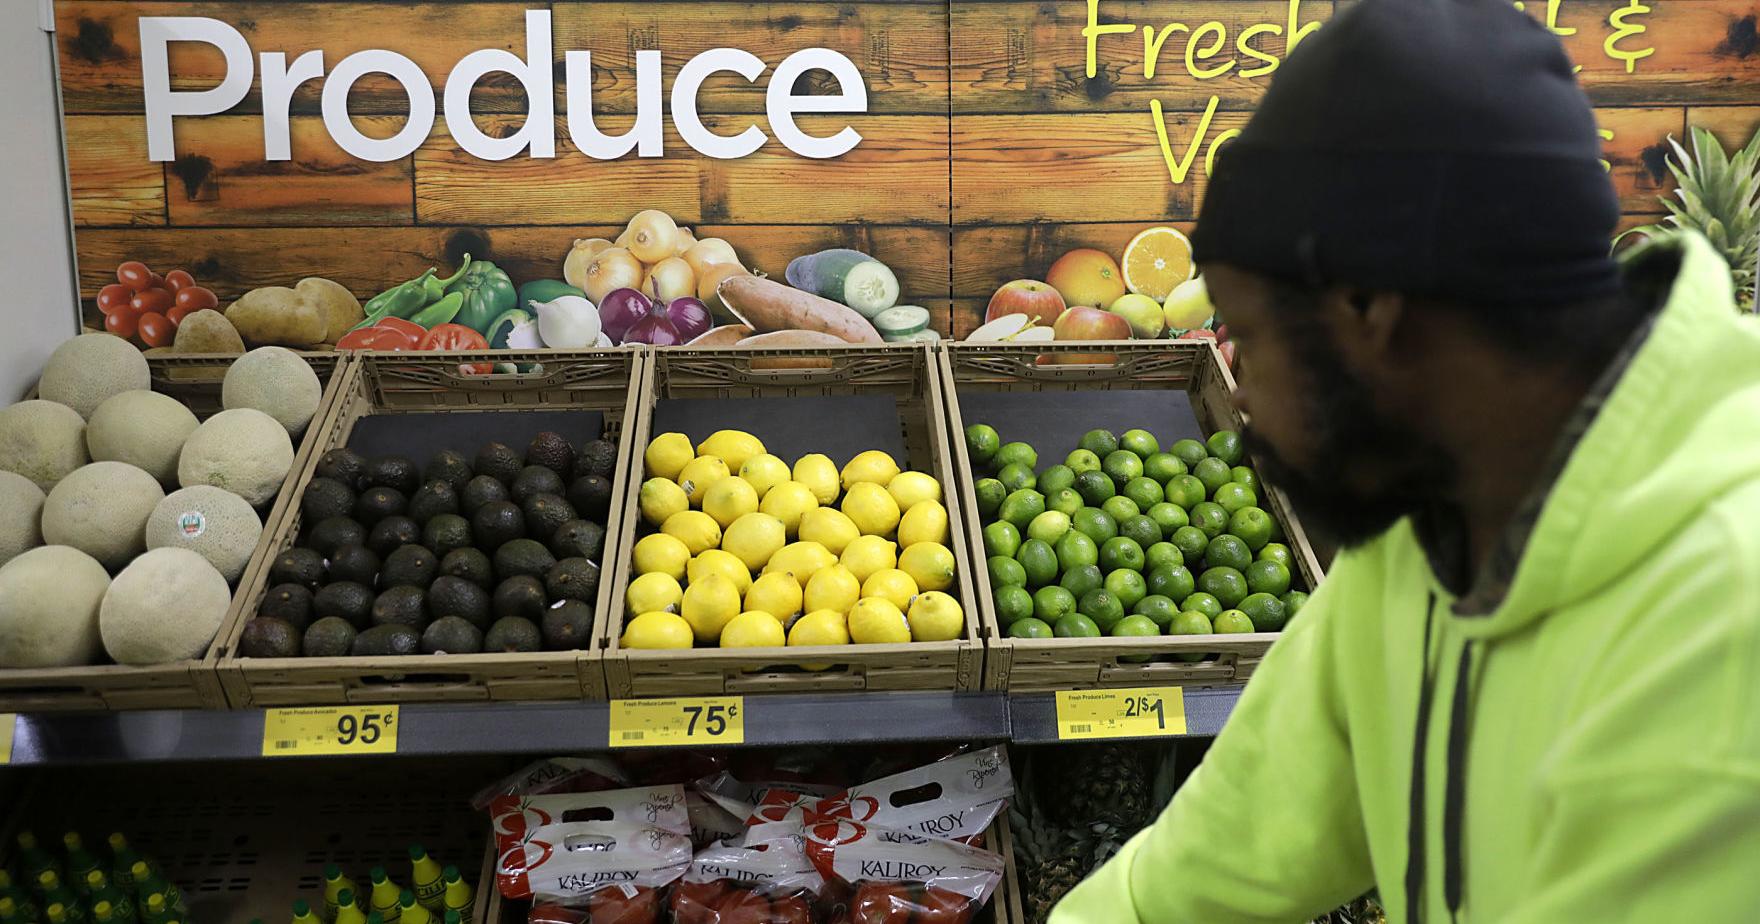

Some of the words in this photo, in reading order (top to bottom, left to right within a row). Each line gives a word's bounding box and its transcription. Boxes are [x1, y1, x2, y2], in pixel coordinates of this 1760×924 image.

[1603, 0, 1655, 74] &
[138, 9, 868, 162] Produce
[861, 860, 947, 879] KALIROY
